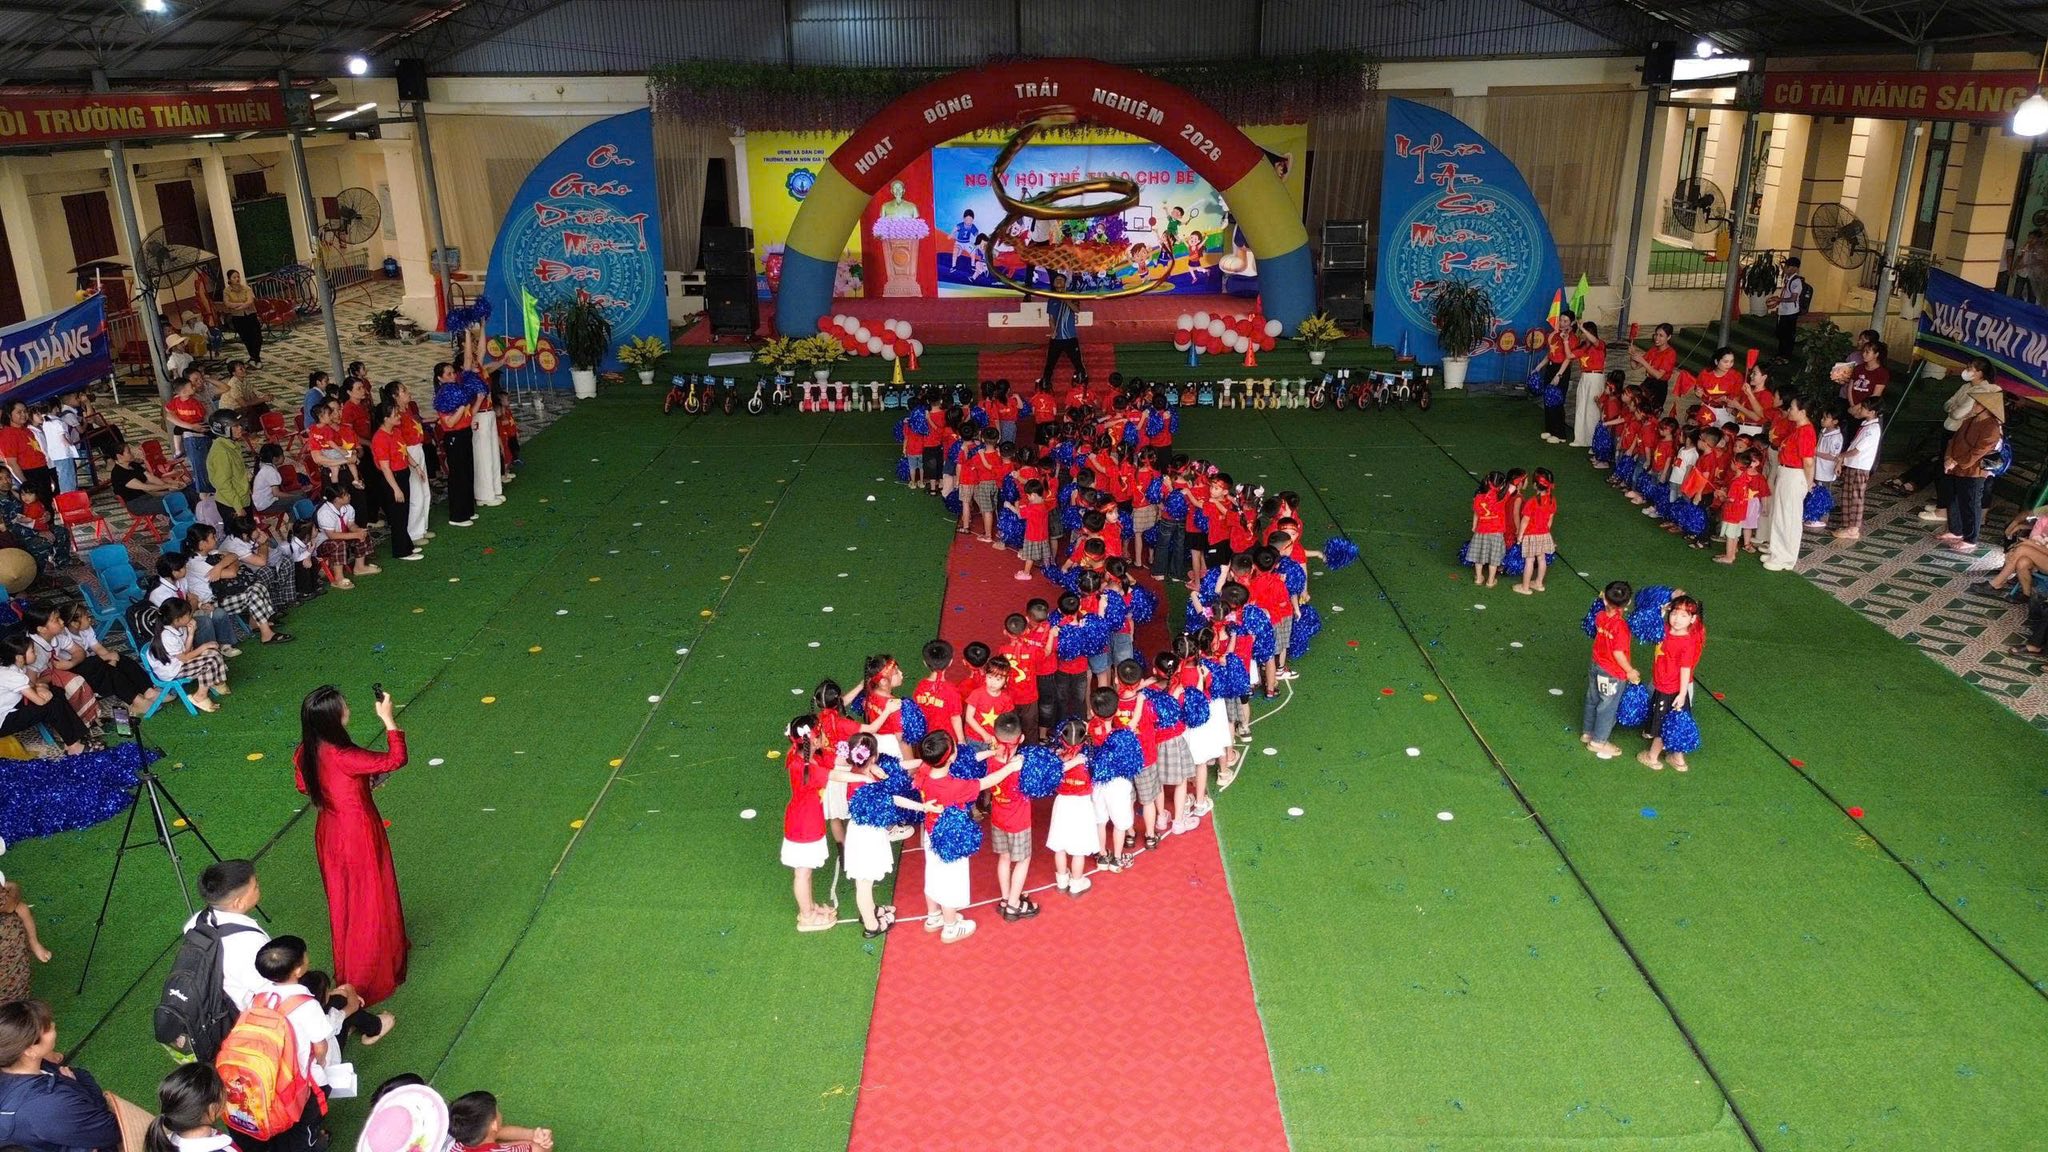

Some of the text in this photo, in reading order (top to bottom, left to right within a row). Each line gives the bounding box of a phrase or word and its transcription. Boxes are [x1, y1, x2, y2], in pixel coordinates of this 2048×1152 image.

[1774, 80, 1804, 105] CÔ
[1809, 81, 1846, 106] TÀI
[1851, 80, 1928, 109] NĂNG
[34, 102, 146, 132] TRƯỜNG
[150, 101, 211, 128] THÂN
[215, 99, 272, 126] THIỆN
[854, 76, 1222, 175] HOẠT ĐỘNG TRẢI NGHIỆM 2026
[965, 172, 1010, 188] NGY
[1015, 170, 1044, 189] HỘI
[1136, 171, 1171, 186] CHO
[1002, 314, 1009, 325] 2
[1036, 307, 1042, 319] 1
[1930, 299, 1979, 343] XUẤT
[1975, 316, 2028, 358] PHÁT
[20, 321, 92, 374] THẮNG
